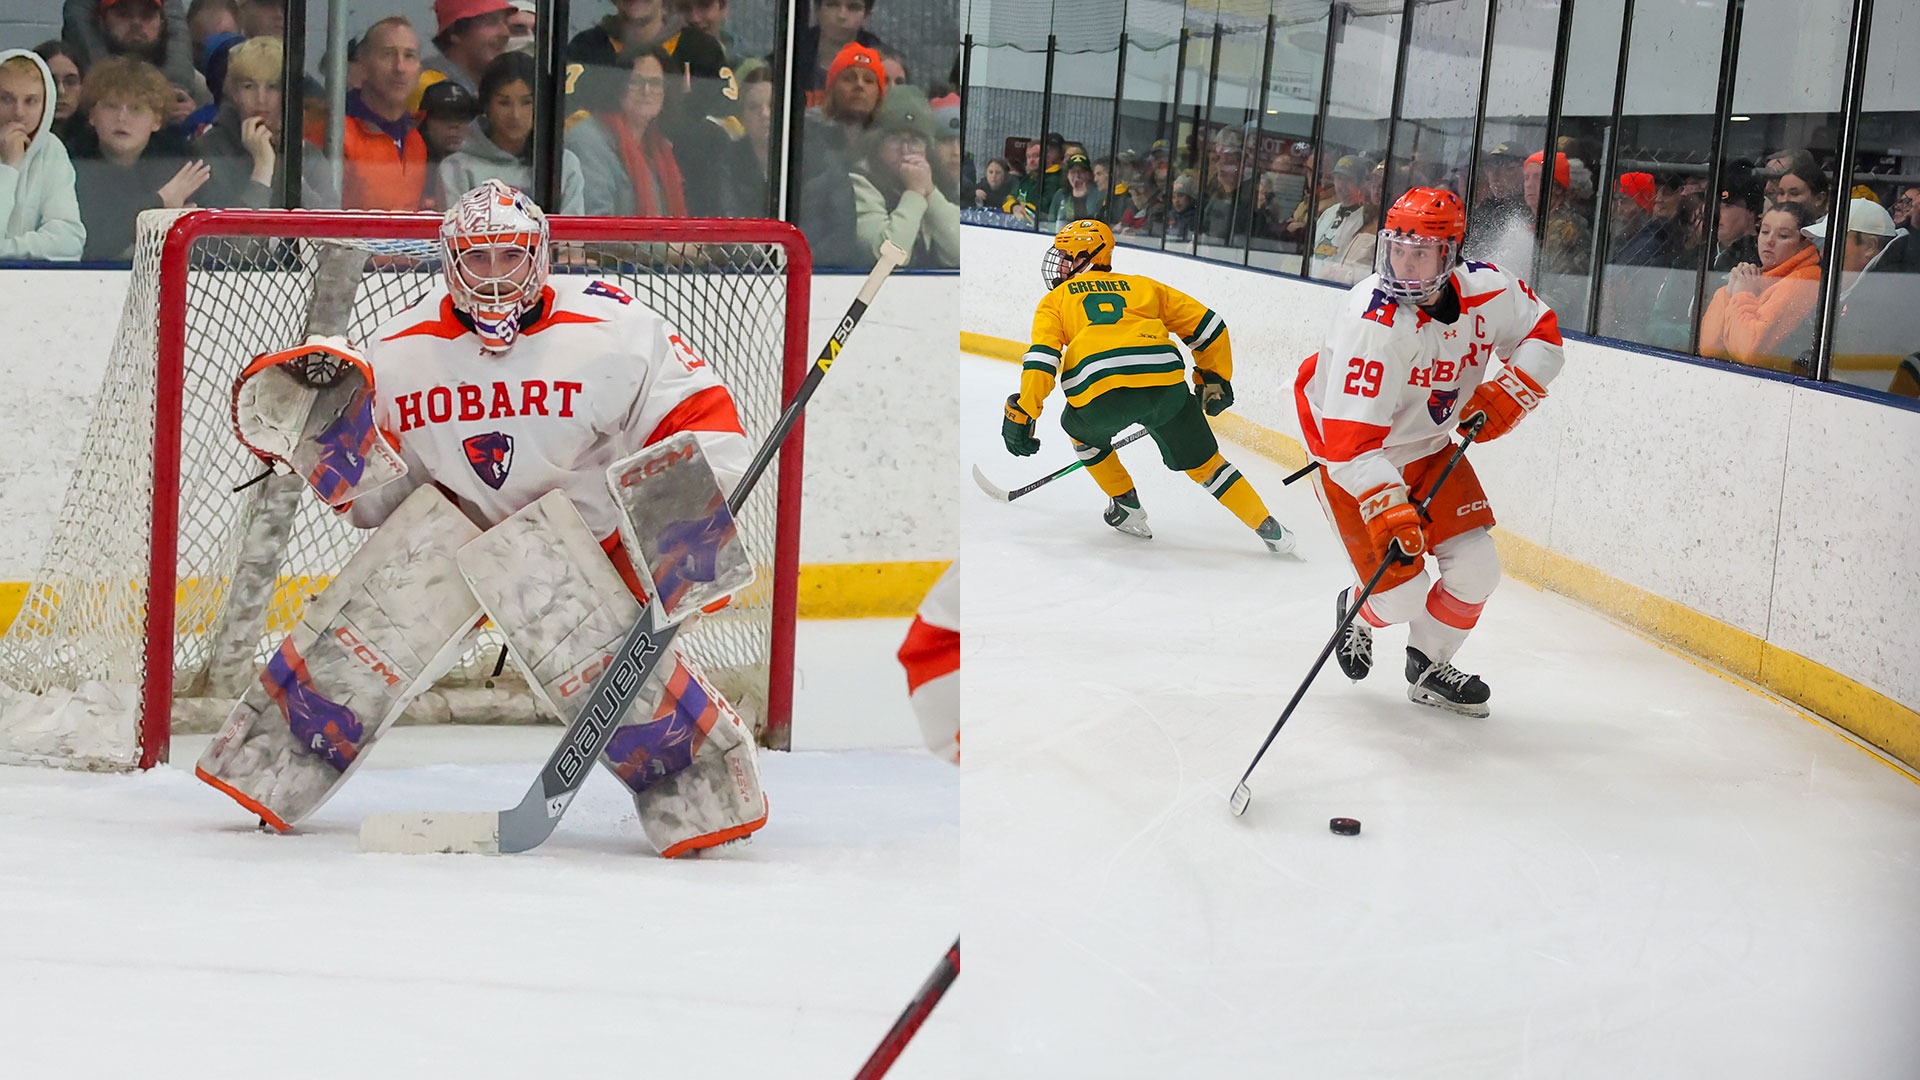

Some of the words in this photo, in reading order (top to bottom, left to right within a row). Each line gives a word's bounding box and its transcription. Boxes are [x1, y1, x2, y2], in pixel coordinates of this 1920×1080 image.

[1068, 280, 1131, 295] GRENIER
[1475, 315, 1486, 338] C
[1343, 357, 1385, 399] 29
[1496, 373, 1539, 411] CC
[395, 381, 582, 431] HOBART
[620, 443, 693, 488] CCM
[335, 626, 401, 687] CCM
[555, 632, 659, 788] BAUER
